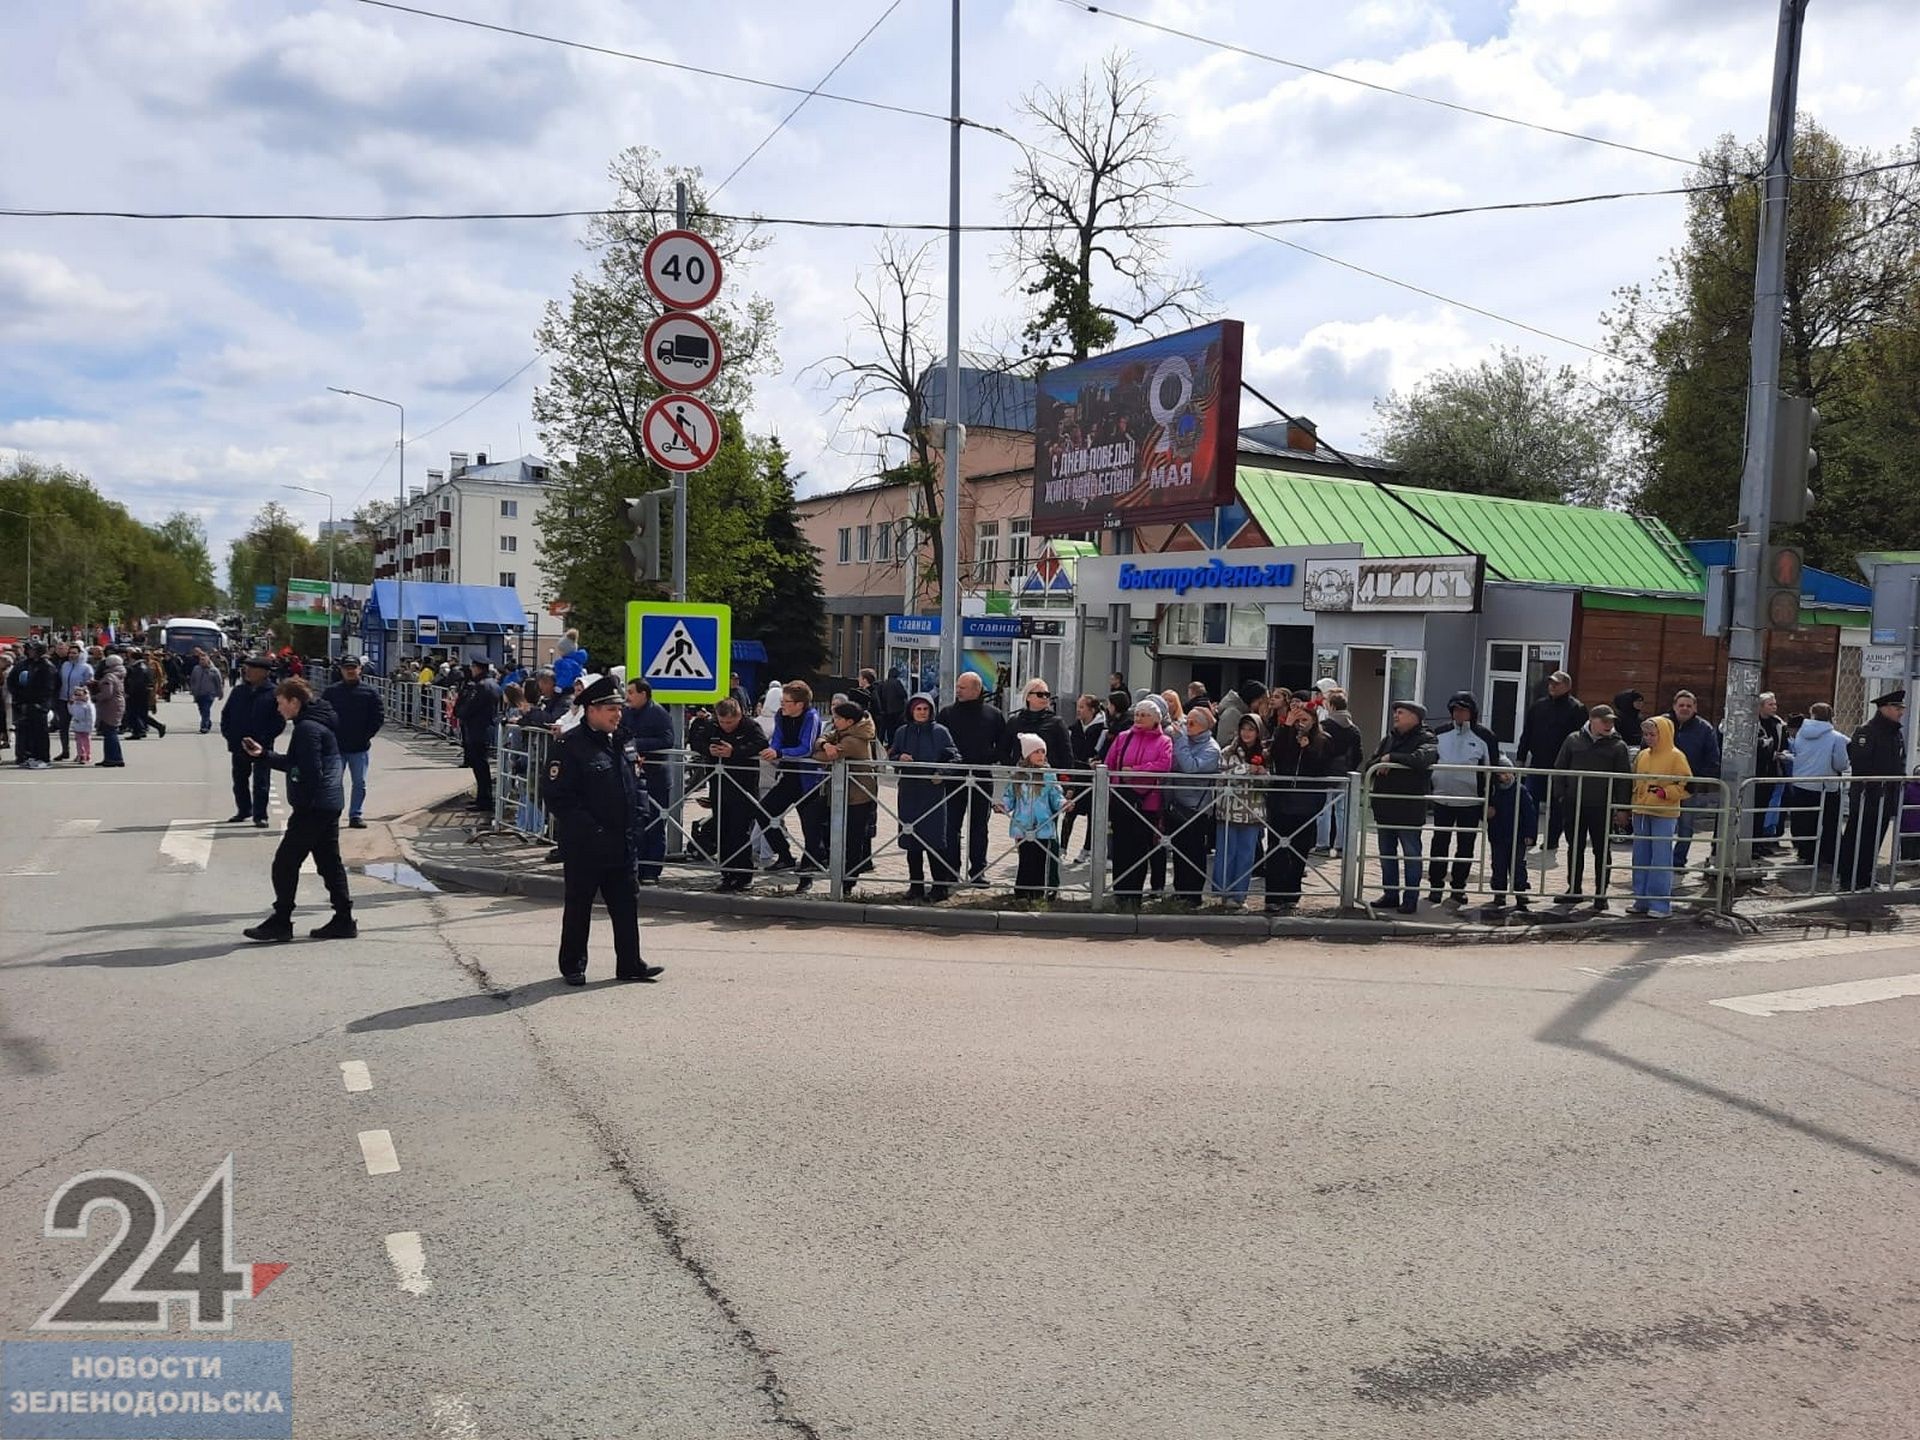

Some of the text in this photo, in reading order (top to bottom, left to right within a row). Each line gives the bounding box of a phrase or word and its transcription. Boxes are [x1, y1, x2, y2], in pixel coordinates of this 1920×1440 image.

[661, 254, 705, 285] 40
[1089, 440, 1136, 470] ПОБЕДЫ!
[1150, 461, 1193, 489] МАЯ
[1118, 558, 1295, 596] Быстроденьги
